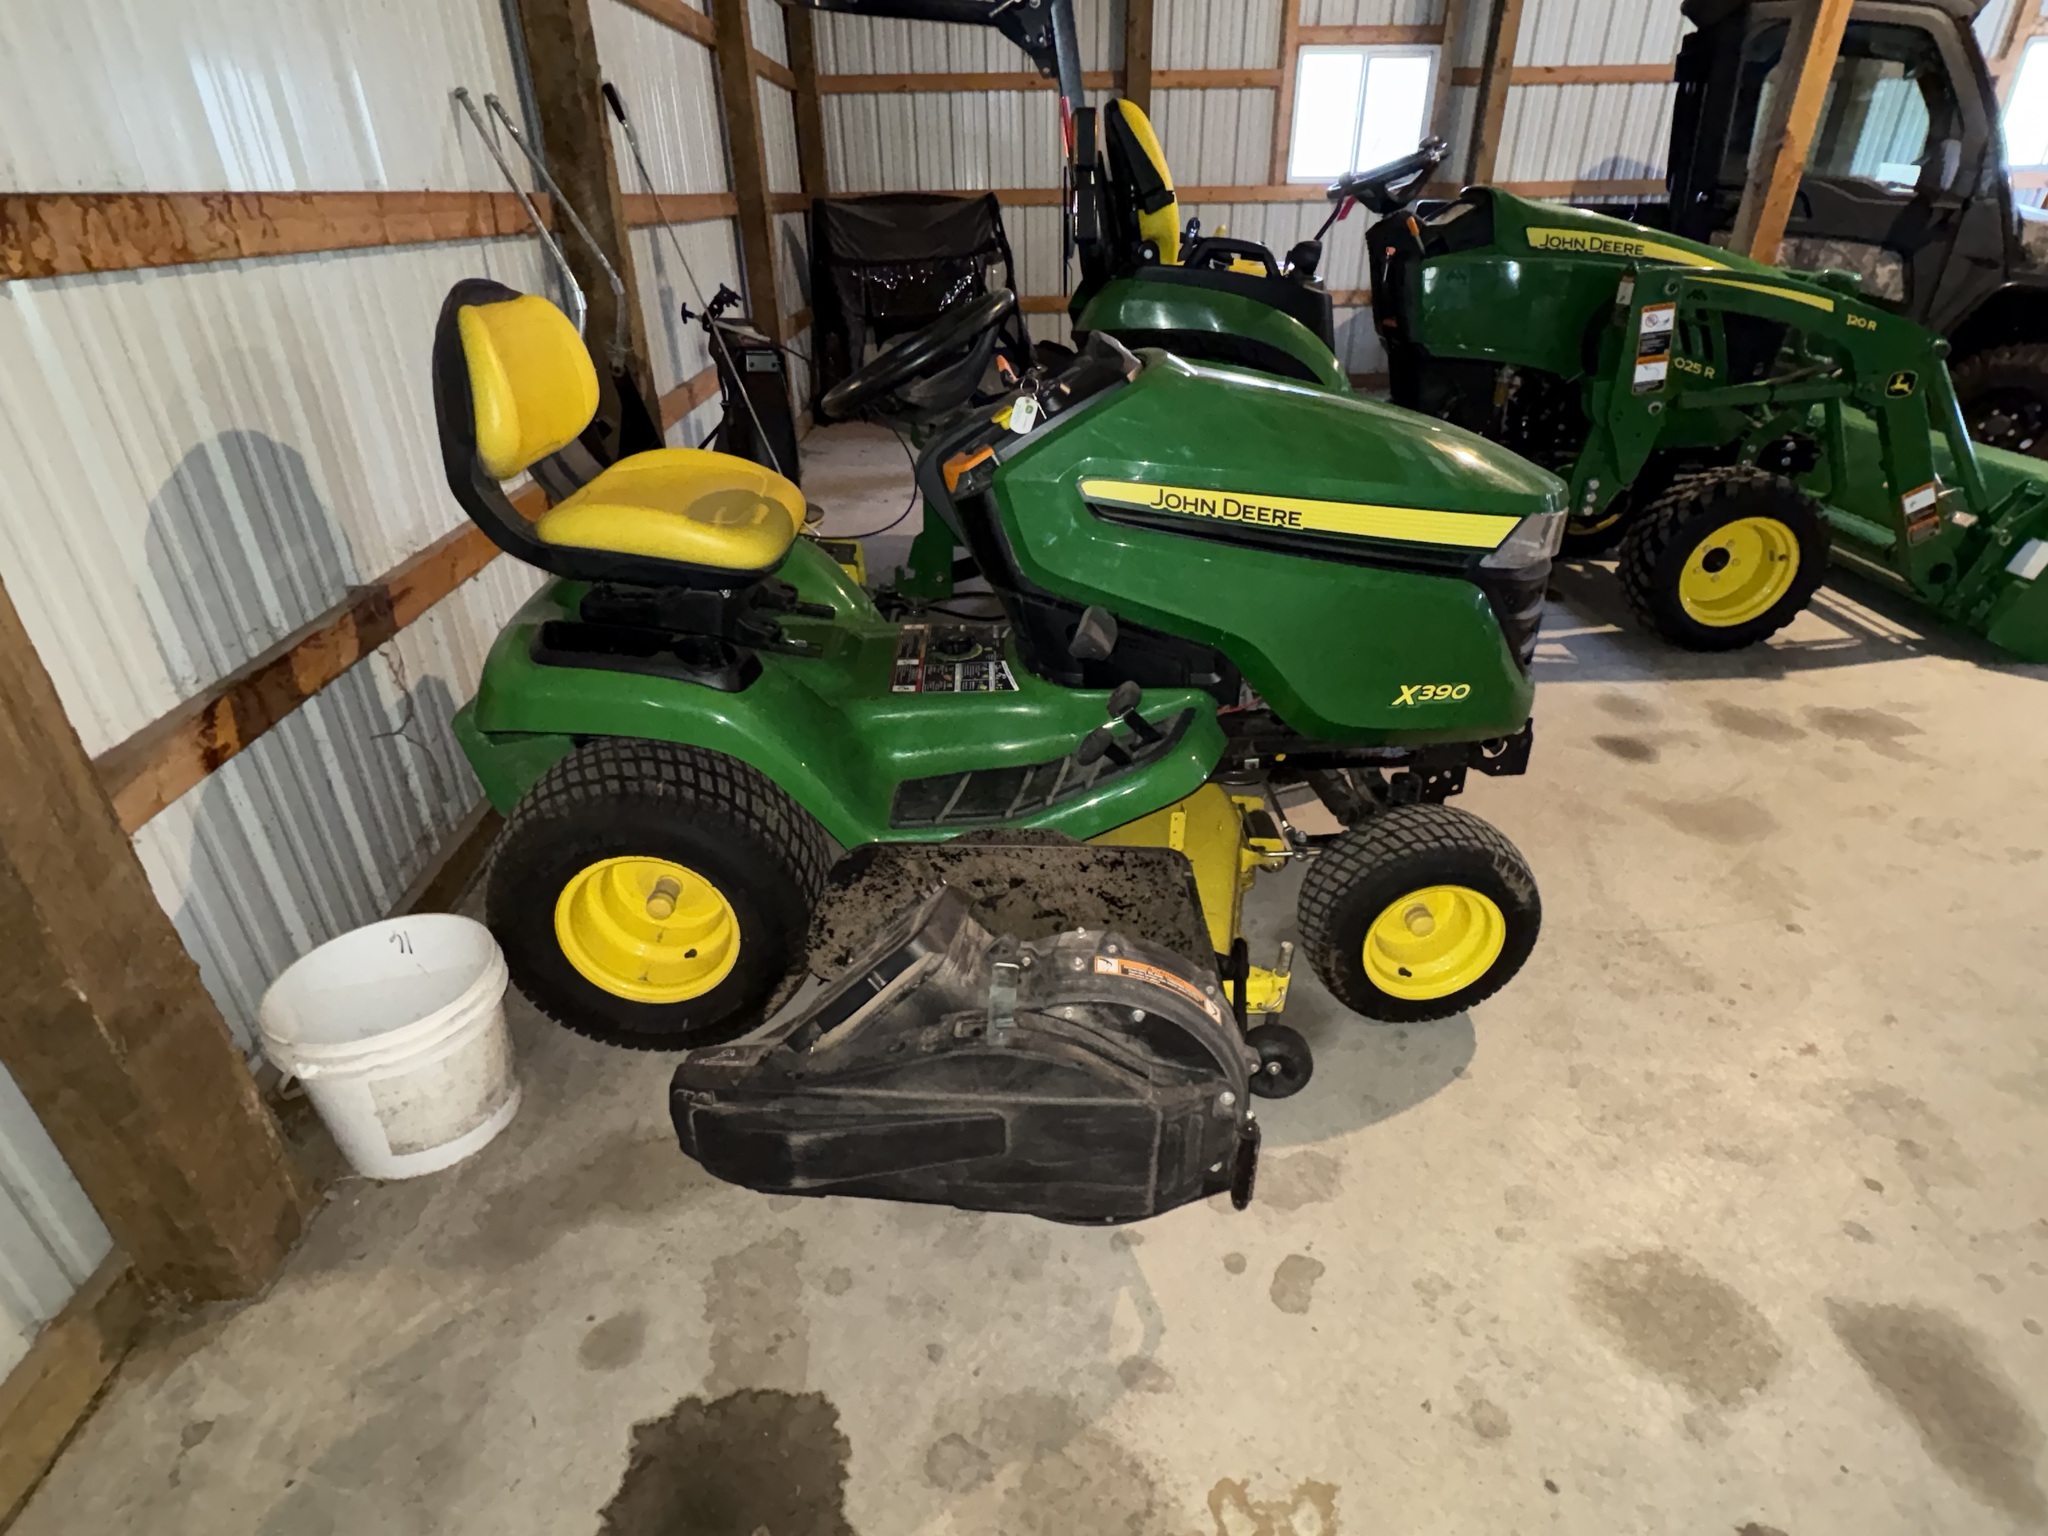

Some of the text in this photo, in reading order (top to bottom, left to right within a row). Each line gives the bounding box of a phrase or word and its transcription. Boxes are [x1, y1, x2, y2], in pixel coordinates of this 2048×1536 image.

[1539, 233, 1645, 256] JOHN DEERE
[1868, 320, 1877, 331] R
[1672, 357, 1702, 375] 025
[1704, 366, 1715, 379] R
[1150, 488, 1303, 528] JOHN DEERE
[1391, 683, 1471, 706] X390
